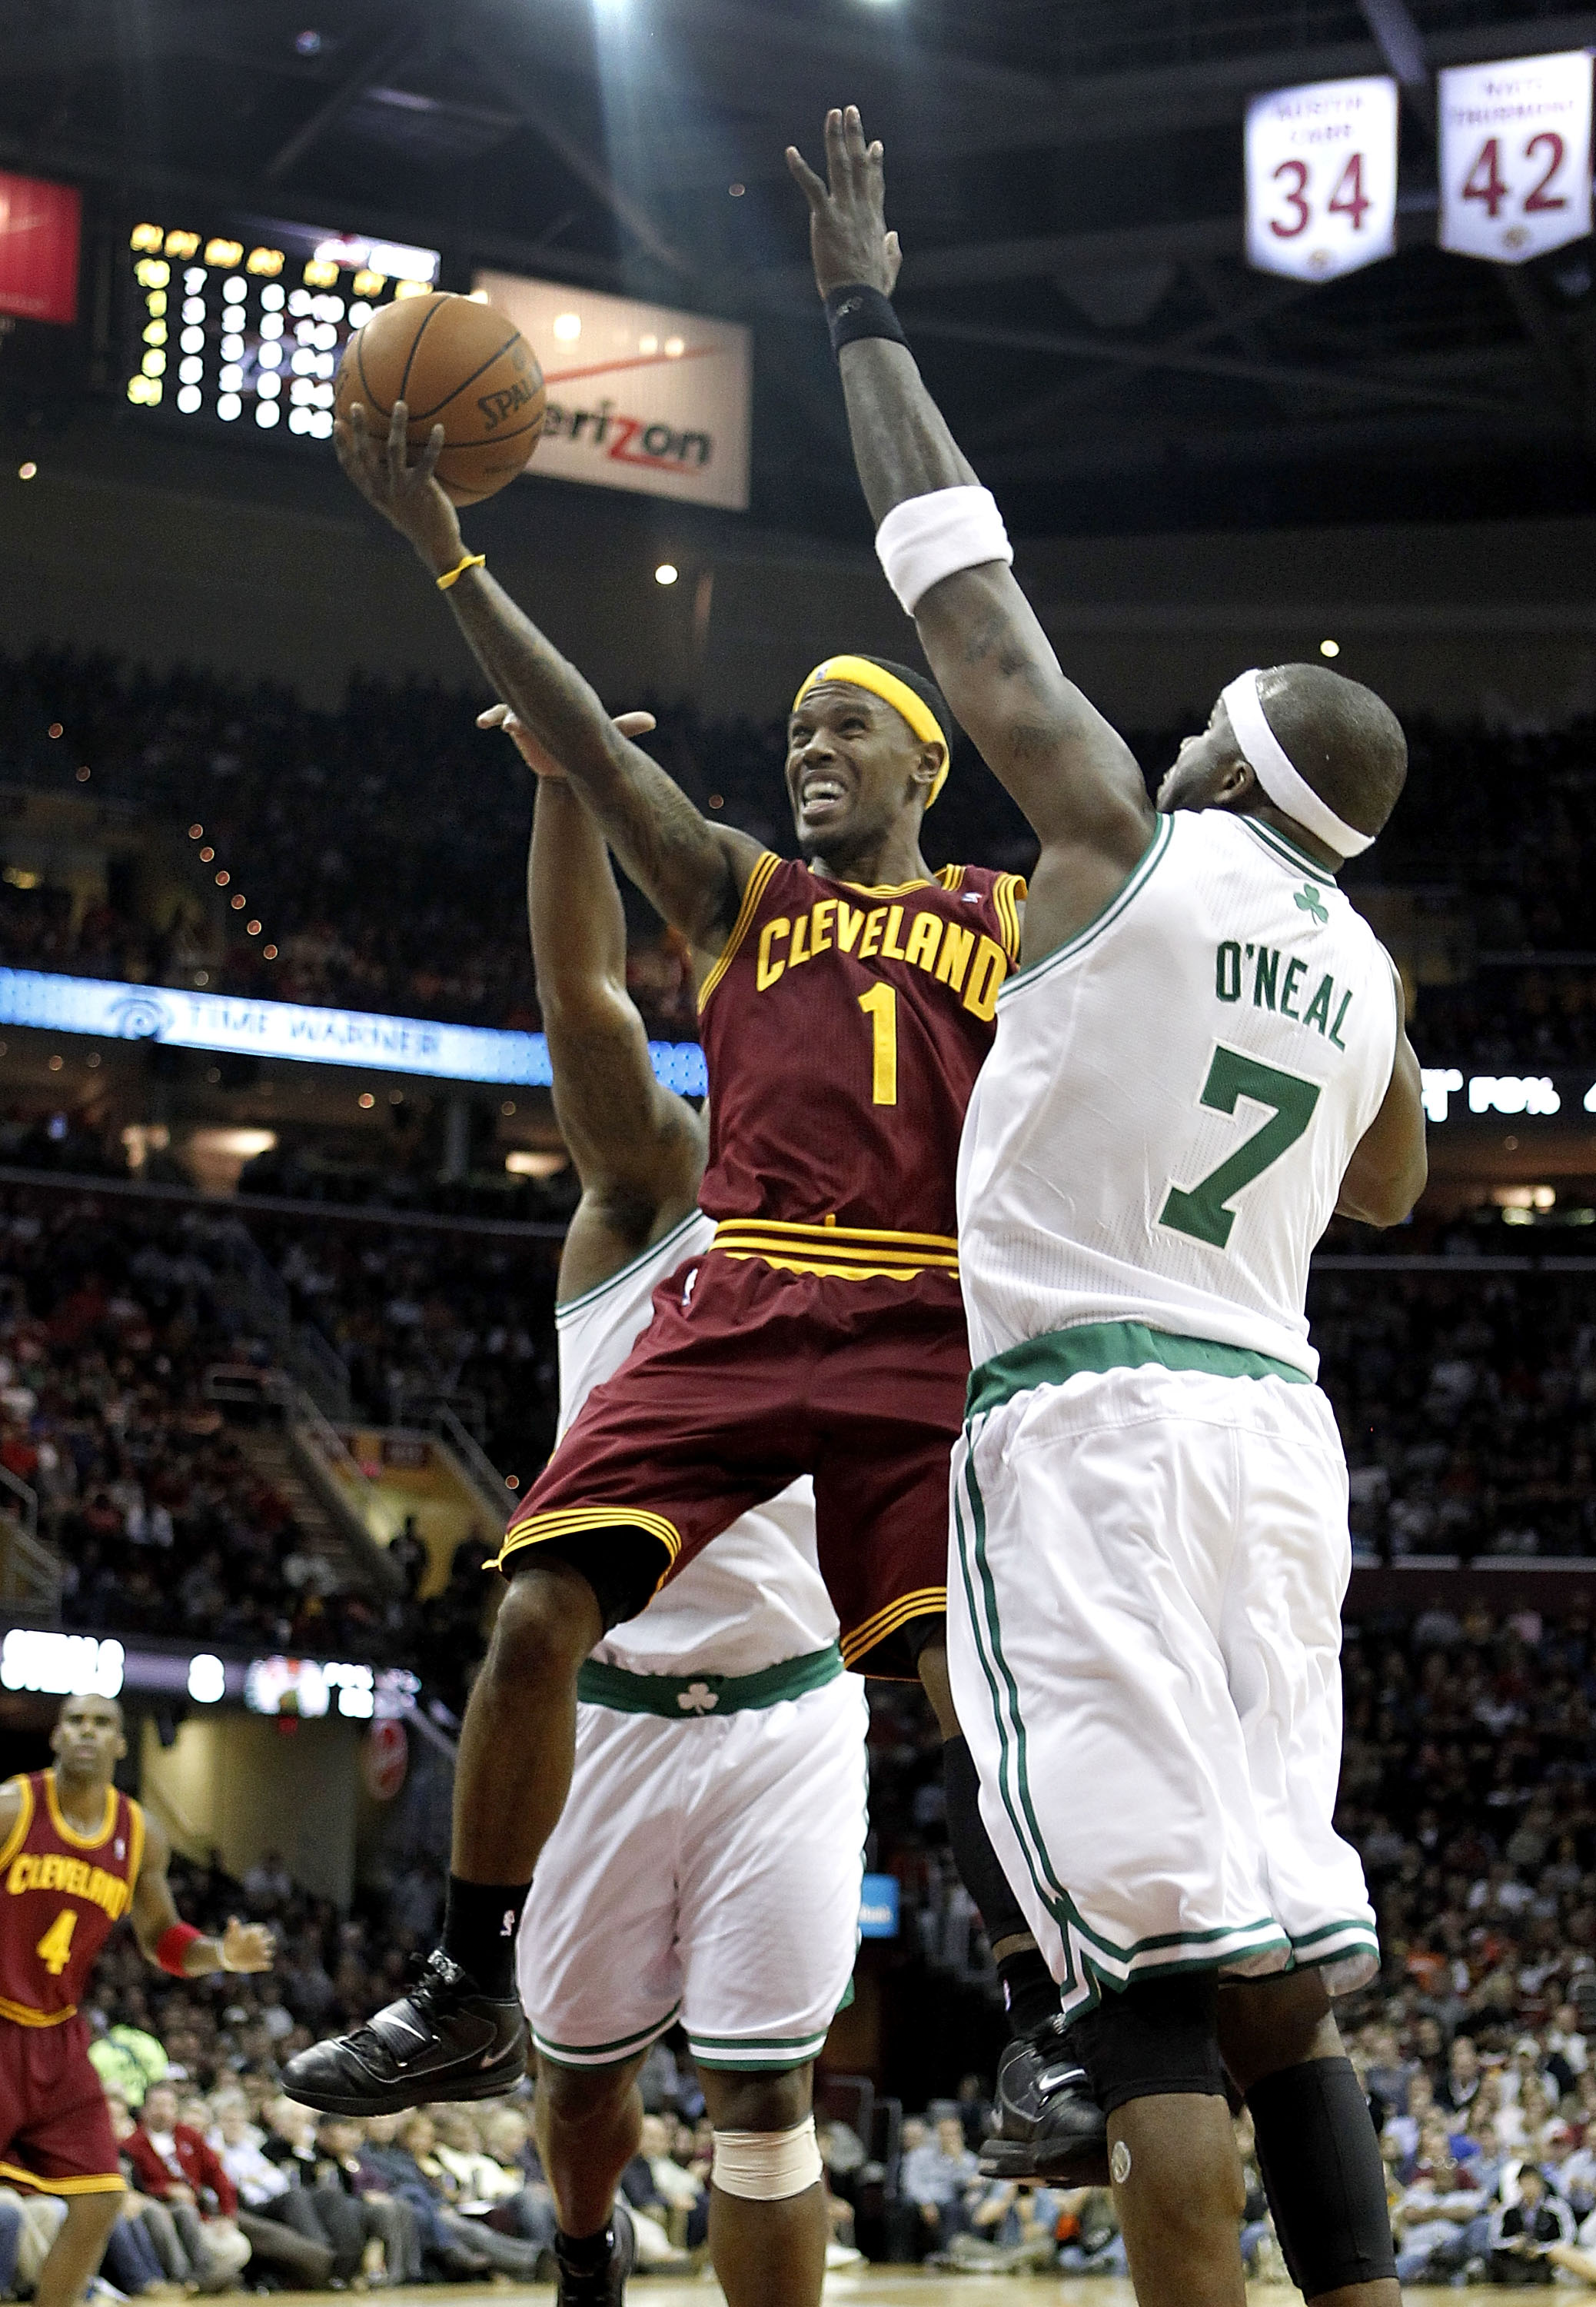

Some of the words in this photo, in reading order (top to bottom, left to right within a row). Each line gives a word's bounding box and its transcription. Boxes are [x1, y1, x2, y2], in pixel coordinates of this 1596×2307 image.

[1270, 152, 1371, 238] 34
[1461, 132, 1566, 218] 42
[477, 377, 541, 431] SPAL
[543, 398, 710, 472] erizon
[756, 898, 1008, 1023] CLEVELAND
[1215, 940, 1353, 1054] O'NEAL
[189, 1003, 269, 1035] TIME
[290, 1017, 441, 1055] WARNER
[857, 980, 897, 1106] 1
[1154, 1039, 1327, 1253] 7
[7, 1852, 130, 1922] CLEVELAND
[36, 1908, 78, 1976] 4
